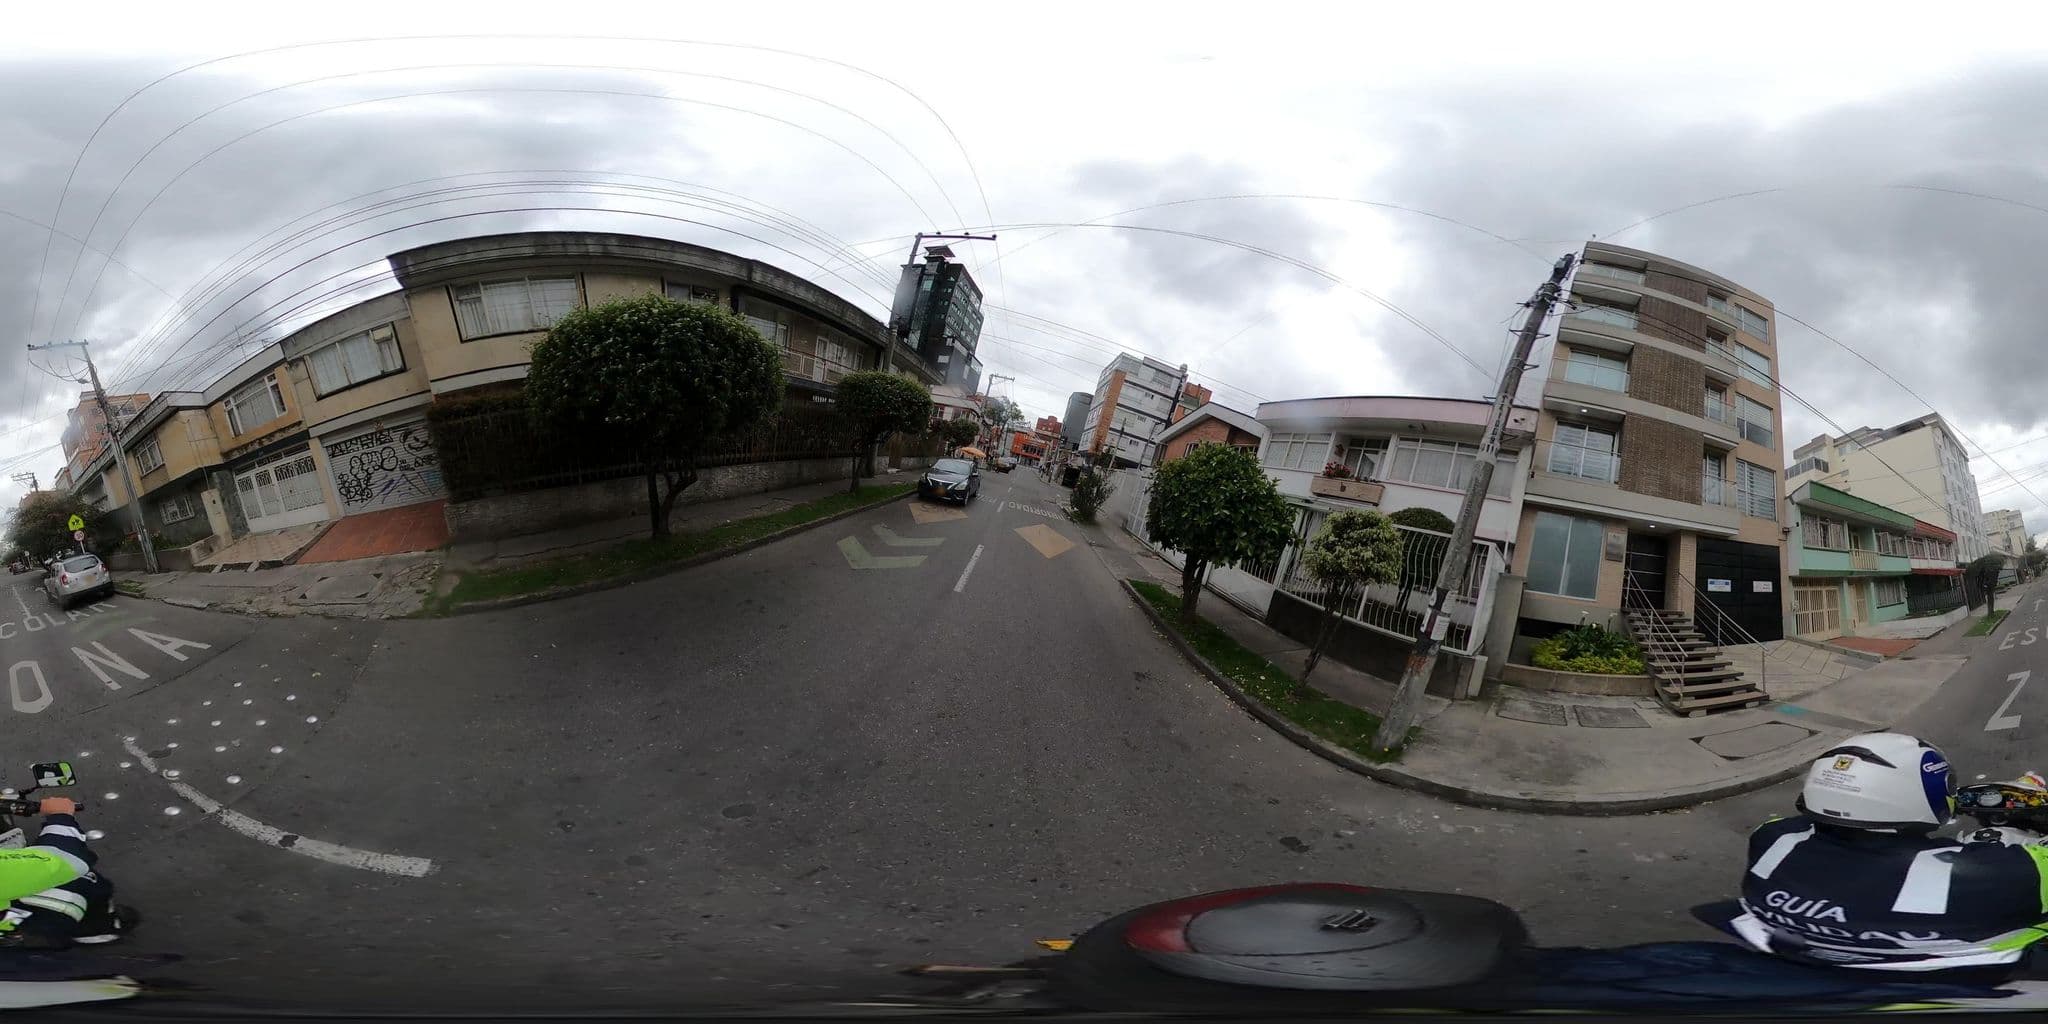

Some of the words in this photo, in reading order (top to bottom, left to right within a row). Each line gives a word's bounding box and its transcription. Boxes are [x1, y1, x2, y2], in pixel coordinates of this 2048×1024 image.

[1998, 627, 2048, 651] ES
[9, 627, 212, 713] ONA
[1984, 670, 2031, 731] Z
[1766, 890, 1847, 922] GUÍA
